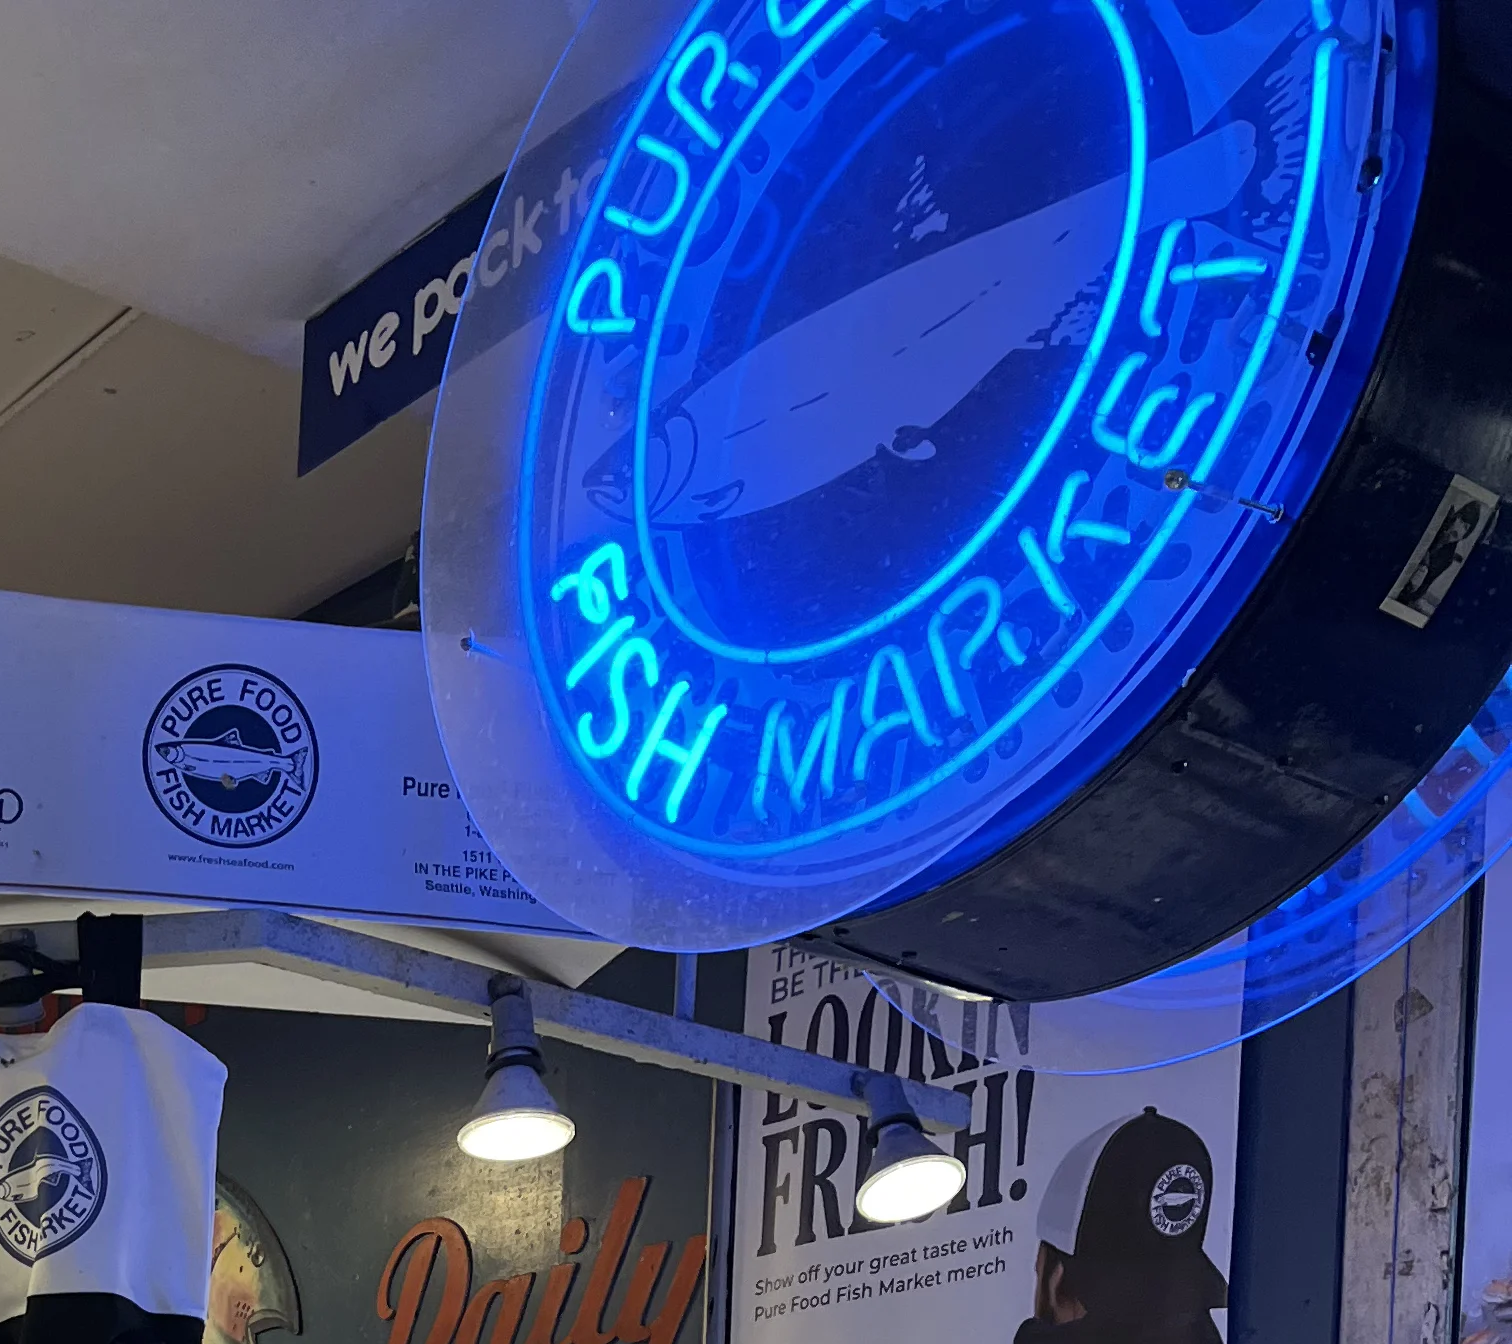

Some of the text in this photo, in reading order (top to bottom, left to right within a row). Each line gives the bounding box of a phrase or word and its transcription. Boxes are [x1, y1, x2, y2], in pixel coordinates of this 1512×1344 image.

[329, 311, 400, 396] we
[161, 678, 303, 744] PURE FOOD
[157, 767, 302, 838] FISH MARKET
[403, 776, 450, 799] Pure
[168, 853, 294, 871] www.freshseafood.com
[414, 862, 429, 875] IN
[432, 864, 461, 878] THE
[466, 866, 498, 881] PIKE
[462, 850, 492, 864] 1511
[425, 880, 476, 897] Seattle,
[38, 1100, 89, 1158] FOOD
[754, 1226, 1013, 1296] Show off your great taste with
[755, 1256, 1006, 1321] Pure Food Fish Market merch
